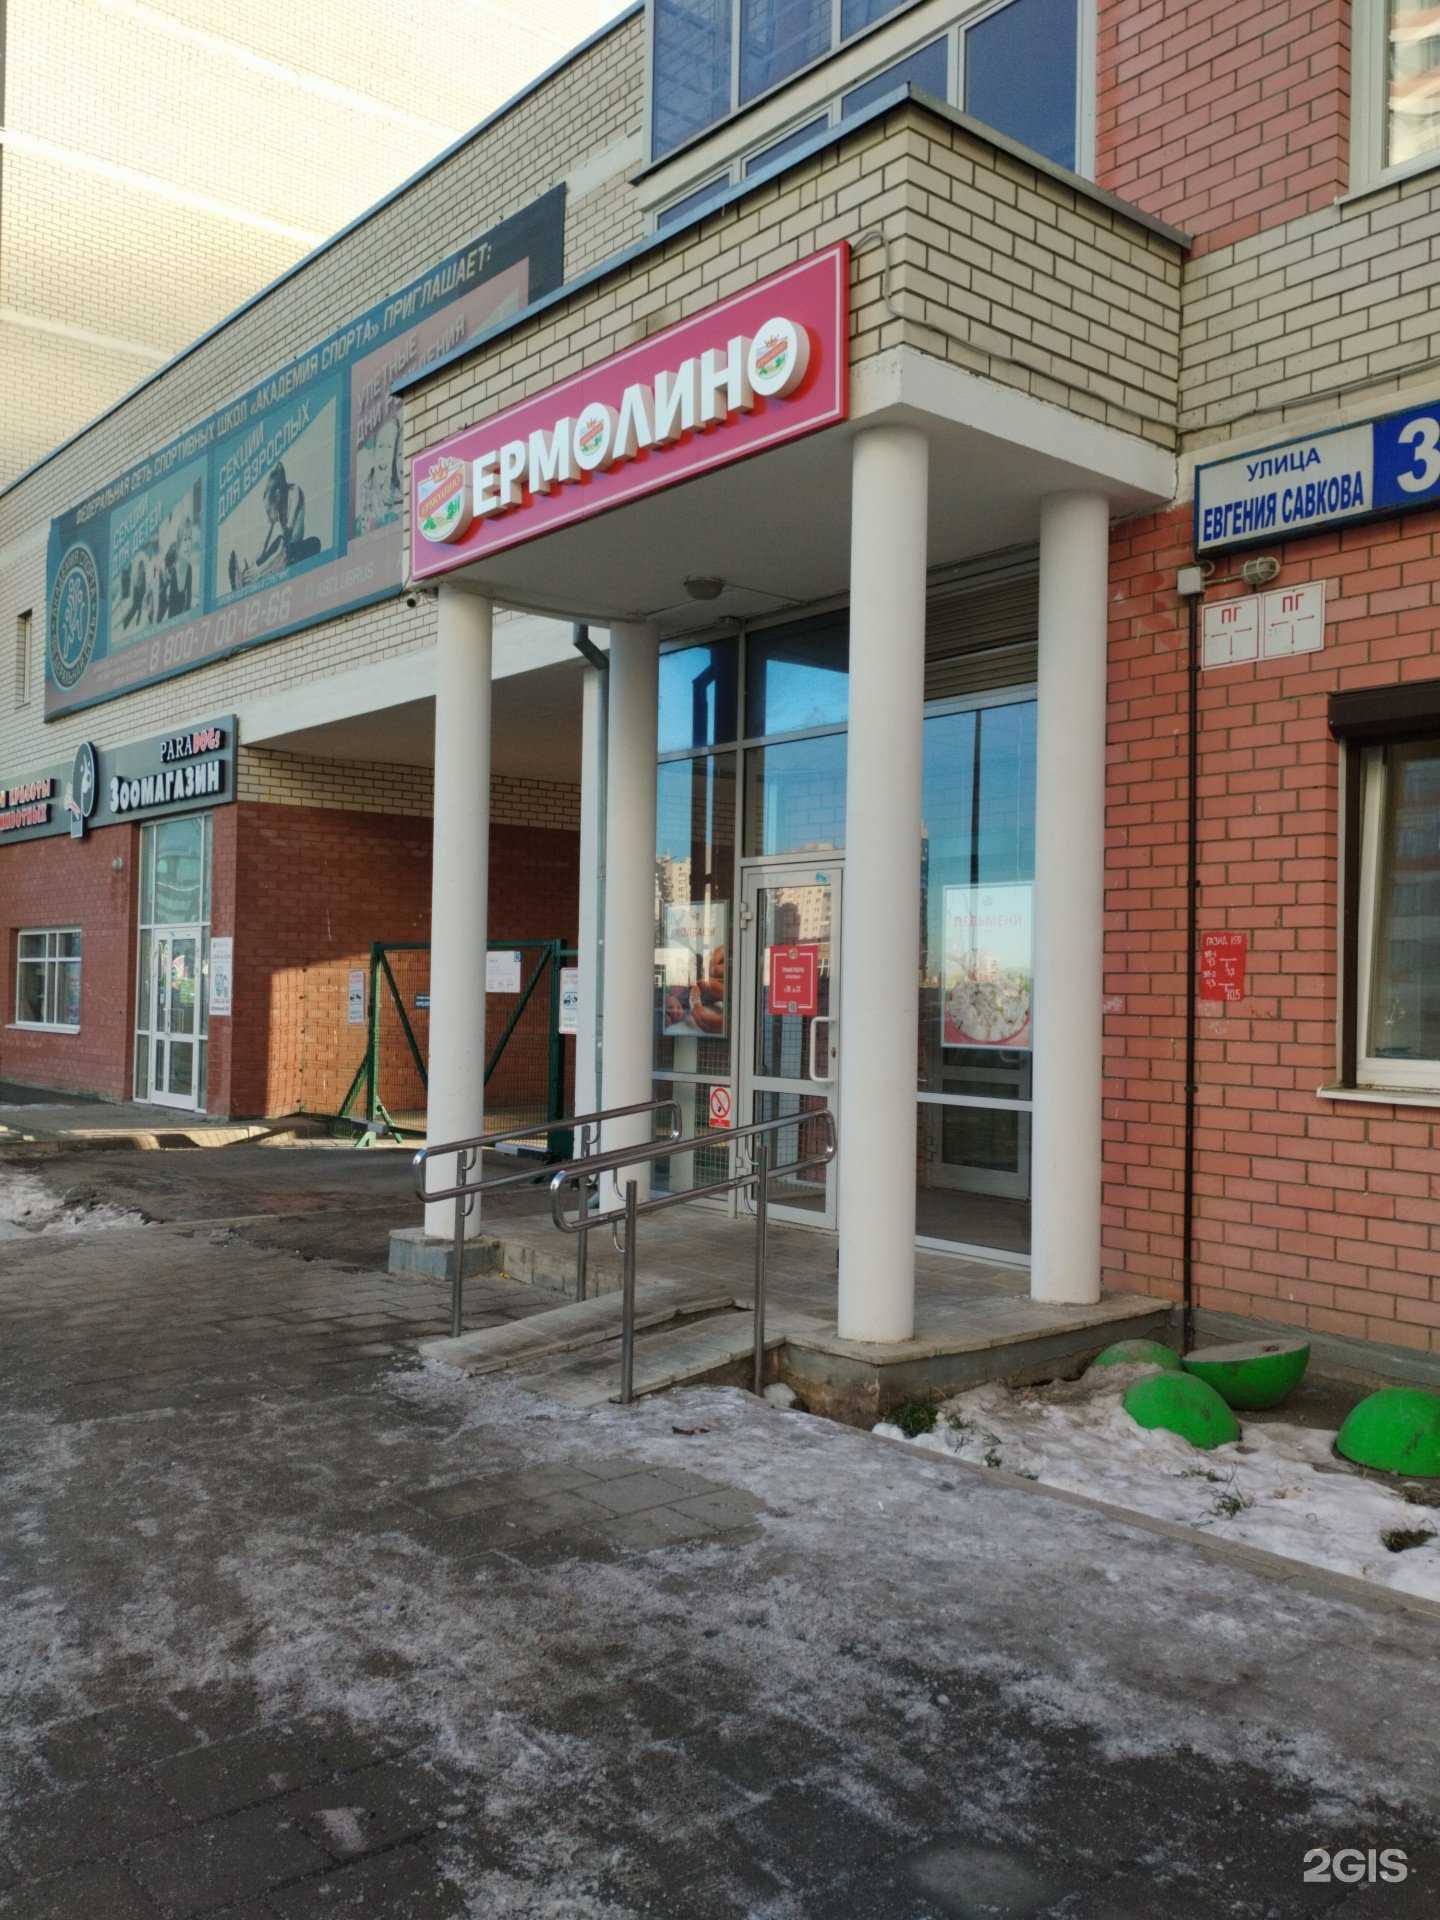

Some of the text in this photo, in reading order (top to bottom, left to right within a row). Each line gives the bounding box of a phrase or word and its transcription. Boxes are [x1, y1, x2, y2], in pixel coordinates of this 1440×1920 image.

[217, 399, 248, 436] ШКОЛ
[384, 241, 492, 332] ПРИГЛАШАЕТ:
[473, 317, 806, 517] ЕРМОЛИНО
[1246, 447, 1321, 482] УЛИЦА
[1203, 470, 1364, 543] ЕВГЕНИЯ САВКОВА
[1221, 606, 1242, 625] ПГ
[1283, 593, 1305, 613] ПГ
